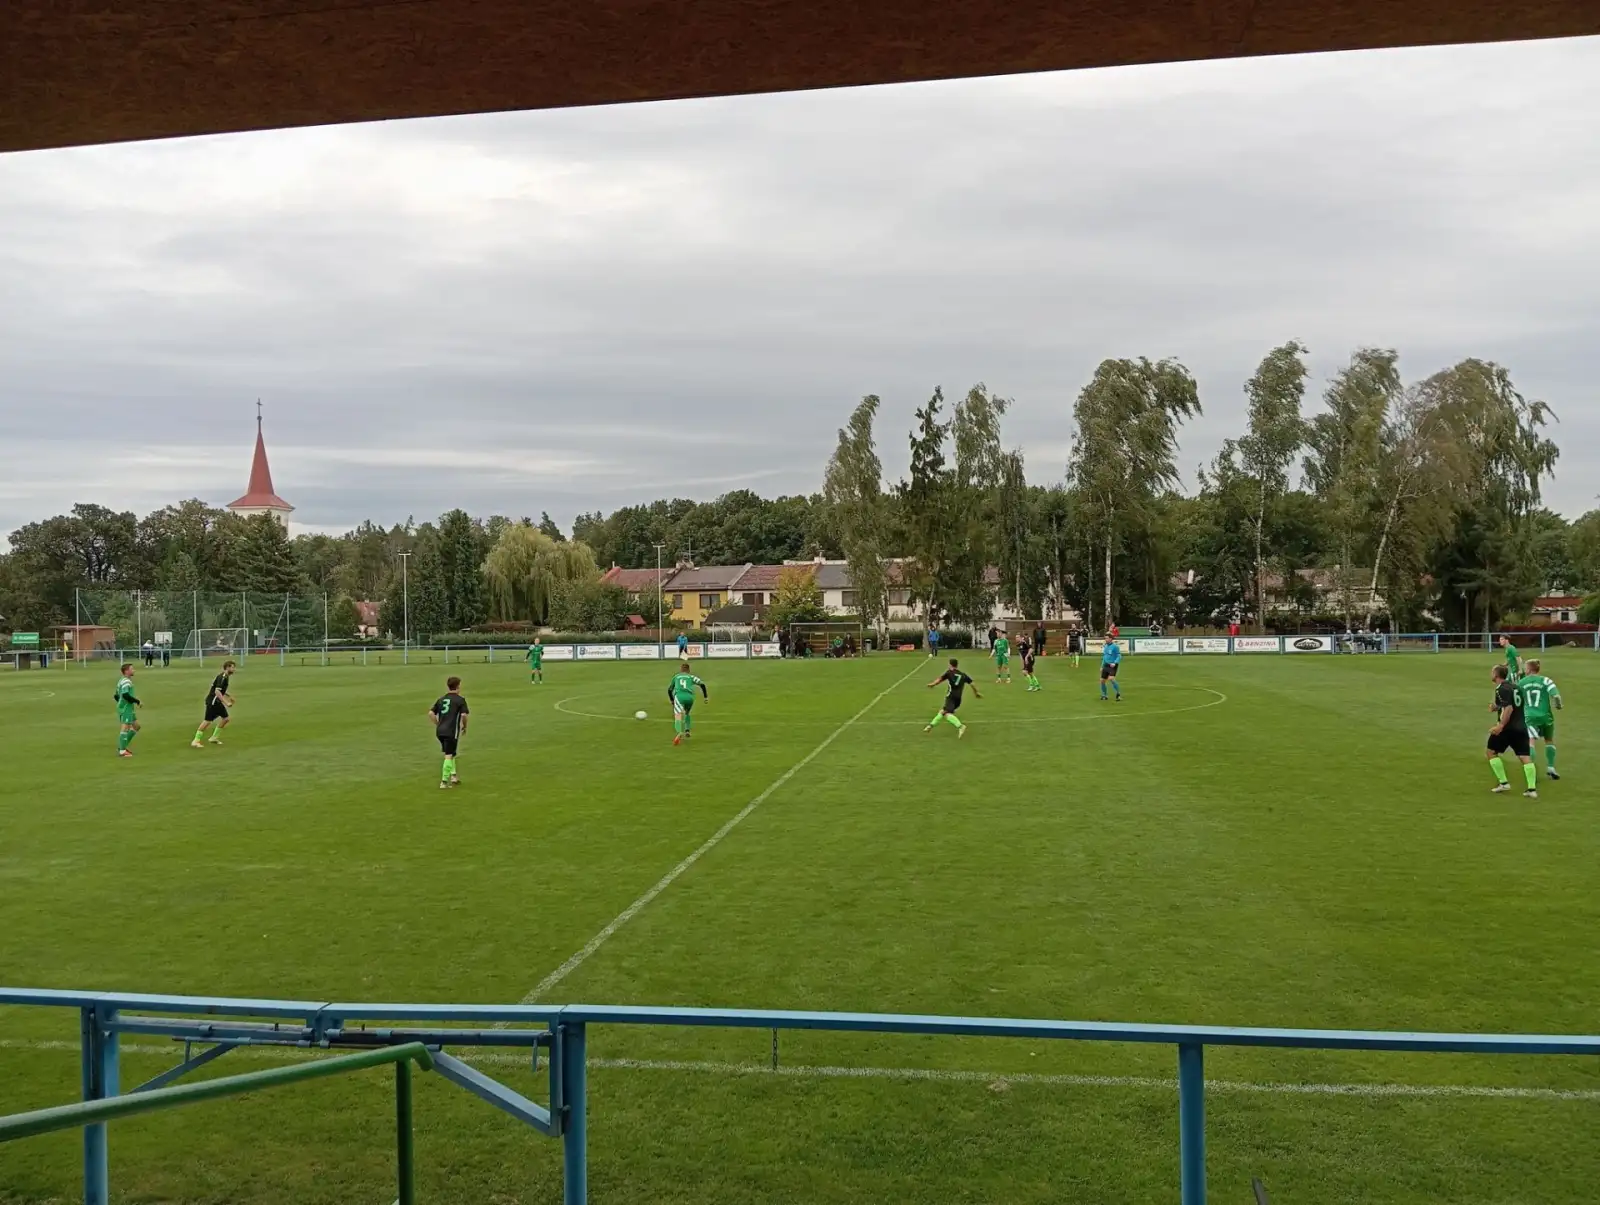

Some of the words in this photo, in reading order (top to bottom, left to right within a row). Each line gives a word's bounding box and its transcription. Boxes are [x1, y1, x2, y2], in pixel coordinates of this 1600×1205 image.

[679, 678, 687, 689] 4
[954, 674, 962, 686] 7
[441, 698, 451, 714] 3
[1513, 689, 1521, 707] 6
[1526, 689, 1541, 707] 17
